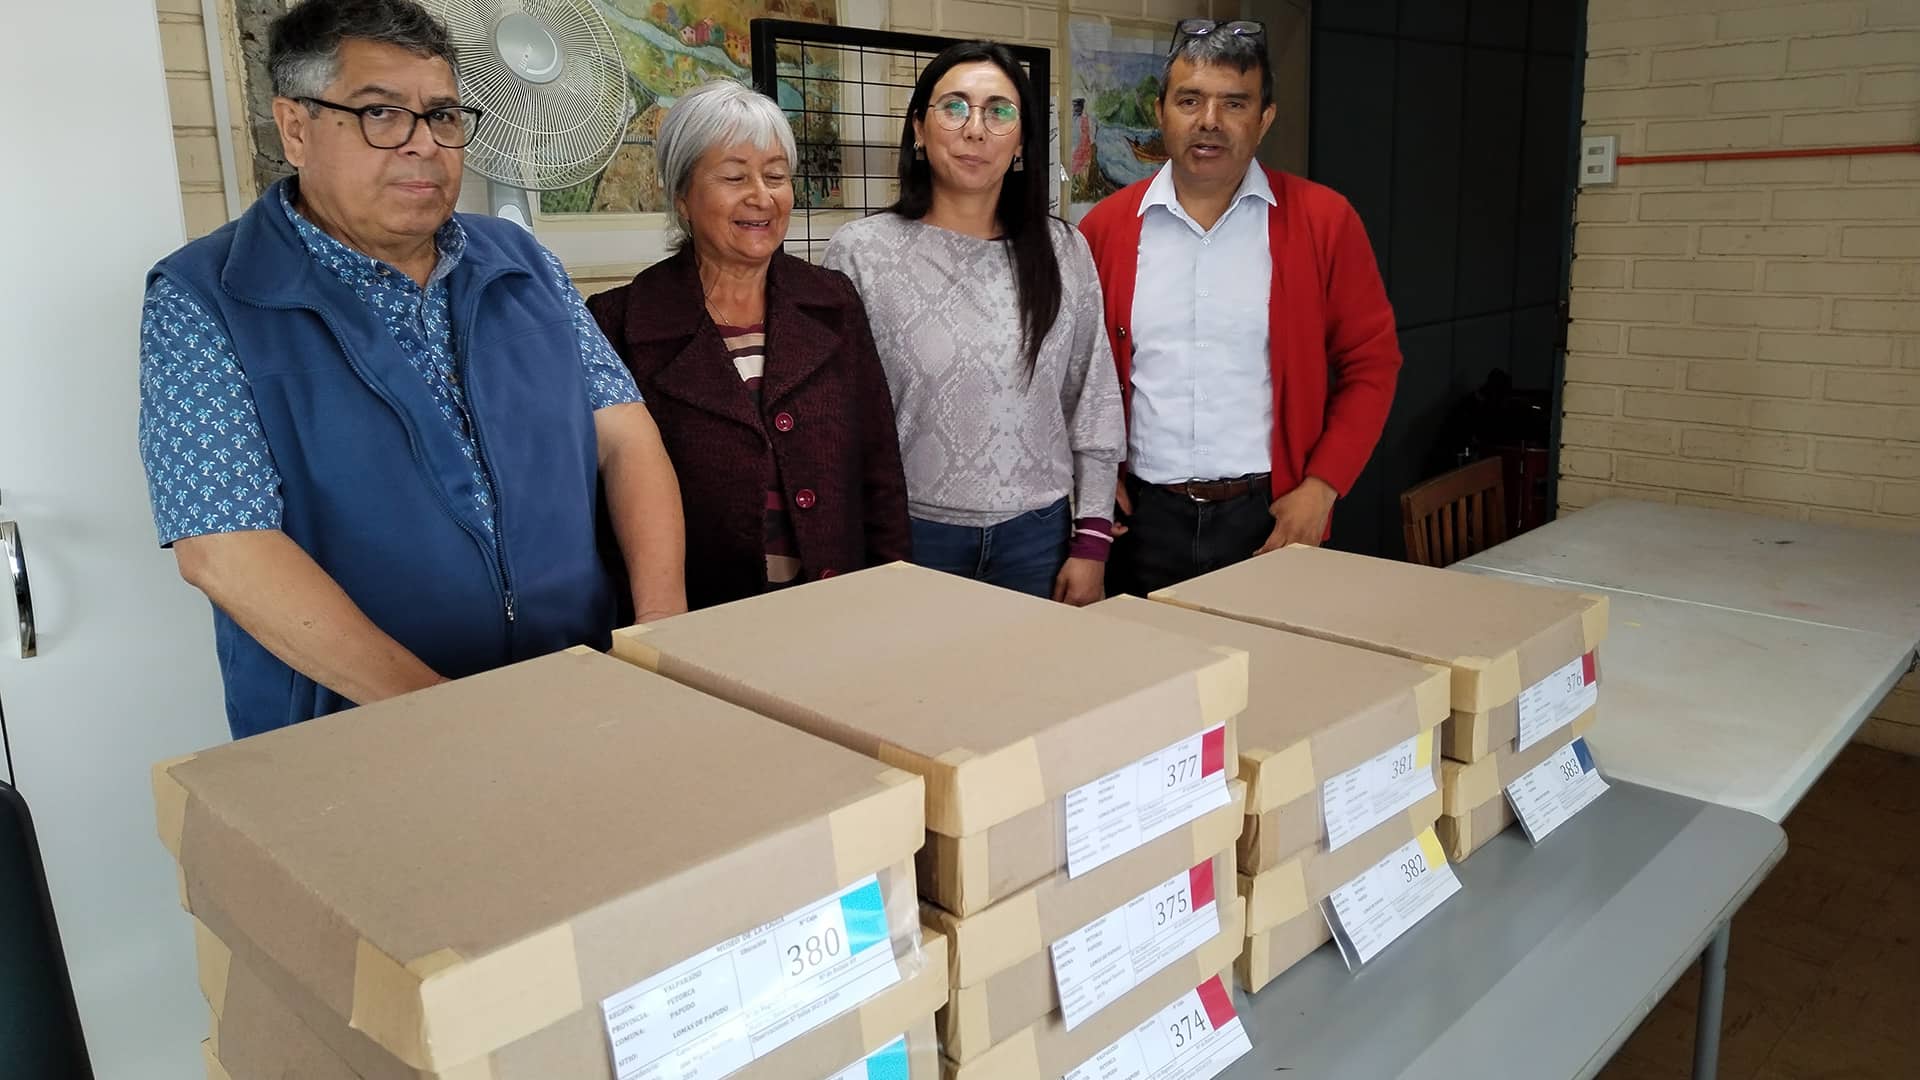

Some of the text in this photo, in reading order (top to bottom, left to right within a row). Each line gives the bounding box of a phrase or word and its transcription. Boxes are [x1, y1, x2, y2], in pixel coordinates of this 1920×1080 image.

[1566, 671, 1582, 694] 376
[1167, 755, 1198, 788] 377
[1391, 753, 1413, 780] 381
[1560, 758, 1580, 783] 383
[1400, 854, 1427, 883] 382
[1155, 889, 1187, 926] 375
[787, 927, 840, 976] 380
[1170, 1009, 1206, 1048] 374
